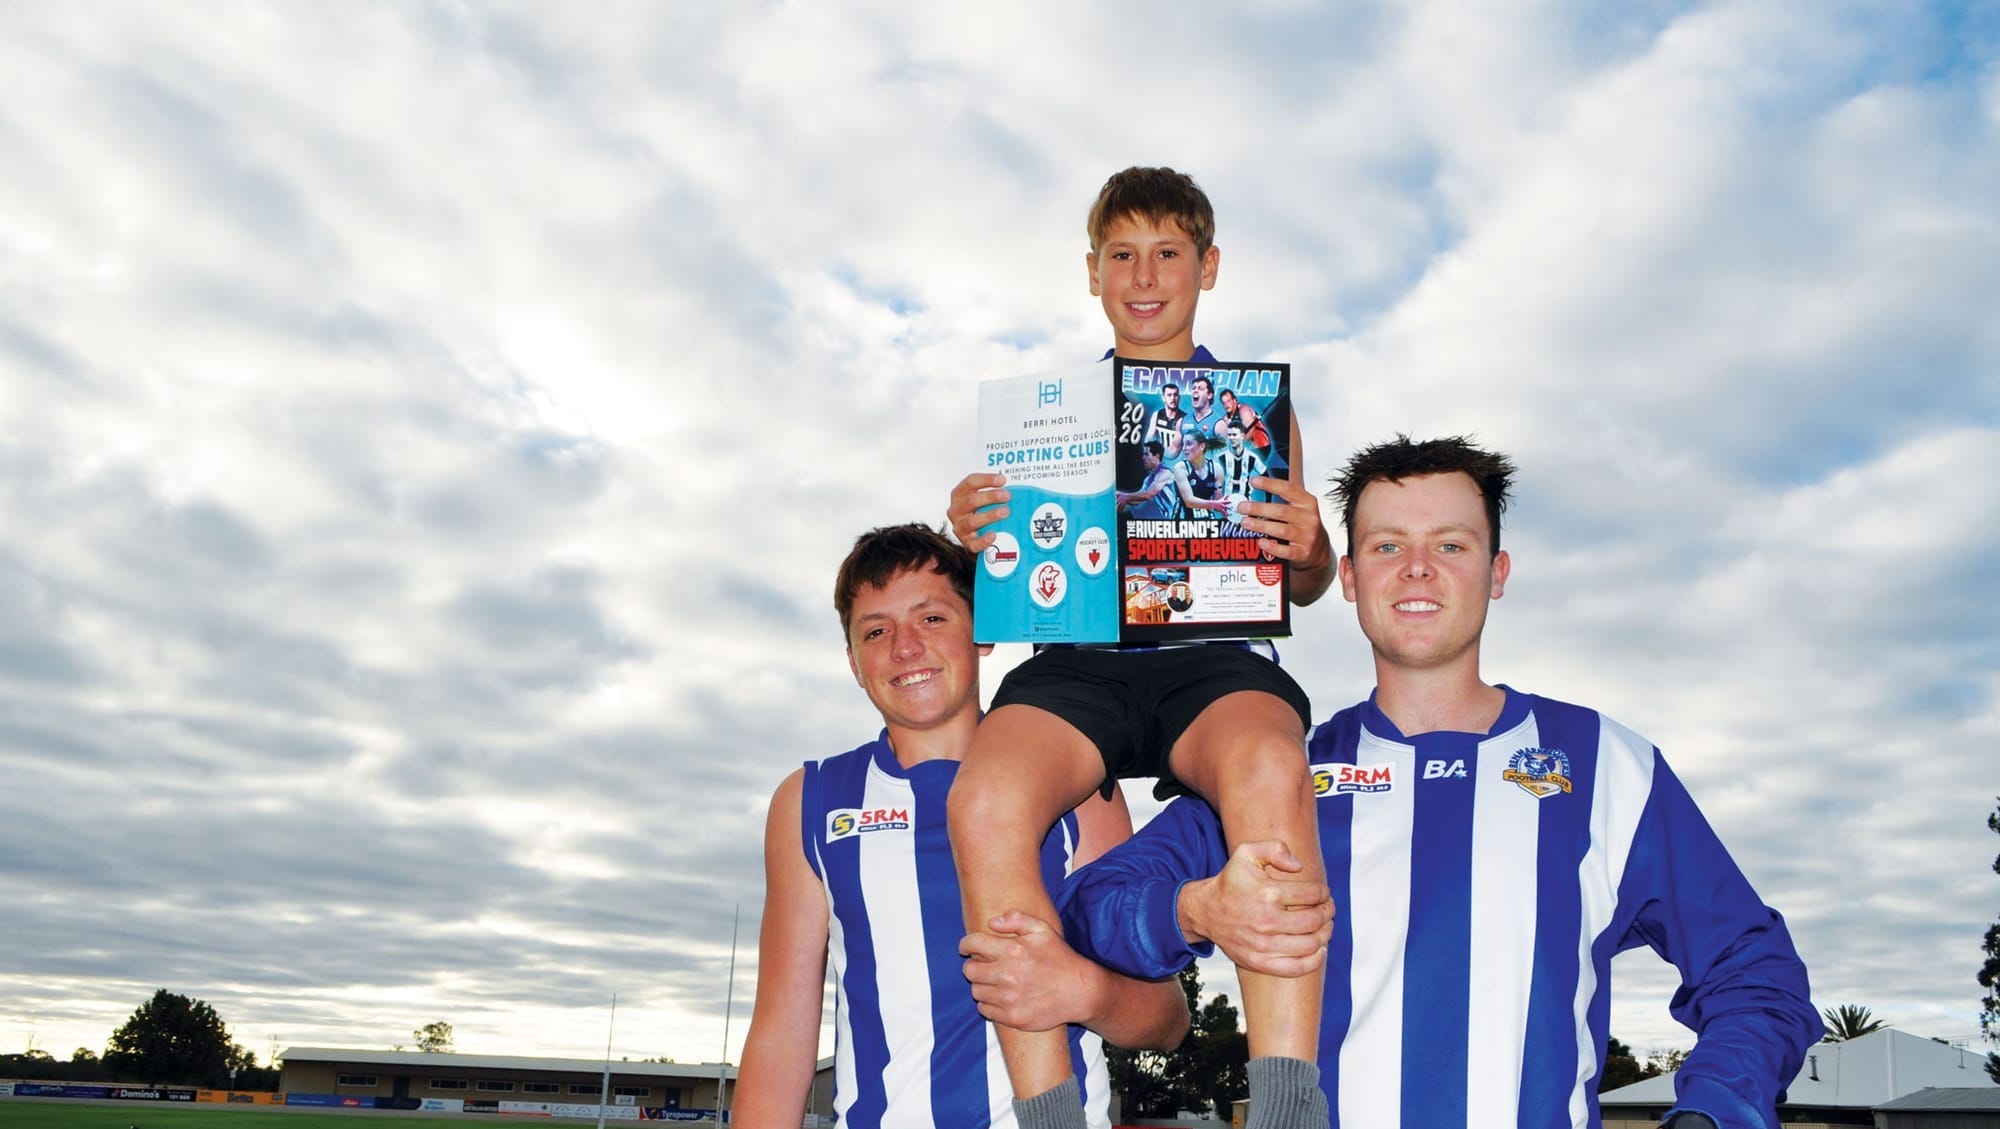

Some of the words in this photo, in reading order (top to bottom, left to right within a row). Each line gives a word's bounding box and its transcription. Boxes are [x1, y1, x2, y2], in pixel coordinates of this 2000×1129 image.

[1023, 419, 1048, 429] BERRI
[1051, 415, 1078, 426] HOTEL
[1120, 402, 1145, 424] 20
[986, 440, 1018, 450] PROUDLY
[1021, 434, 1069, 447] SUPPORTING
[1072, 432, 1088, 441] OUR
[1119, 422, 1143, 445] 26
[988, 446, 1063, 467] SPORTING
[1069, 439, 1109, 459] CLUBS
[1004, 465, 1031, 475] WISHING
[1034, 464, 1050, 472] THEM
[1053, 462, 1064, 470] ALL
[1079, 459, 1093, 468] BEST
[1023, 471, 1060, 480] UPCOMING
[1063, 468, 1088, 477] SEASON
[1126, 520, 1135, 538] THE
[1136, 520, 1219, 539] RIVERLAND'S
[1128, 538, 1187, 561] SPORTS
[1190, 538, 1261, 561] PREVIEW
[1220, 569, 1247, 587] phlc
[1338, 766, 1391, 785] 5RM
[1423, 759, 1466, 780] BA
[859, 808, 909, 825] 5RM
[120, 1089, 160, 1099] Domino's
[661, 1110, 698, 1119] Tyrepower
